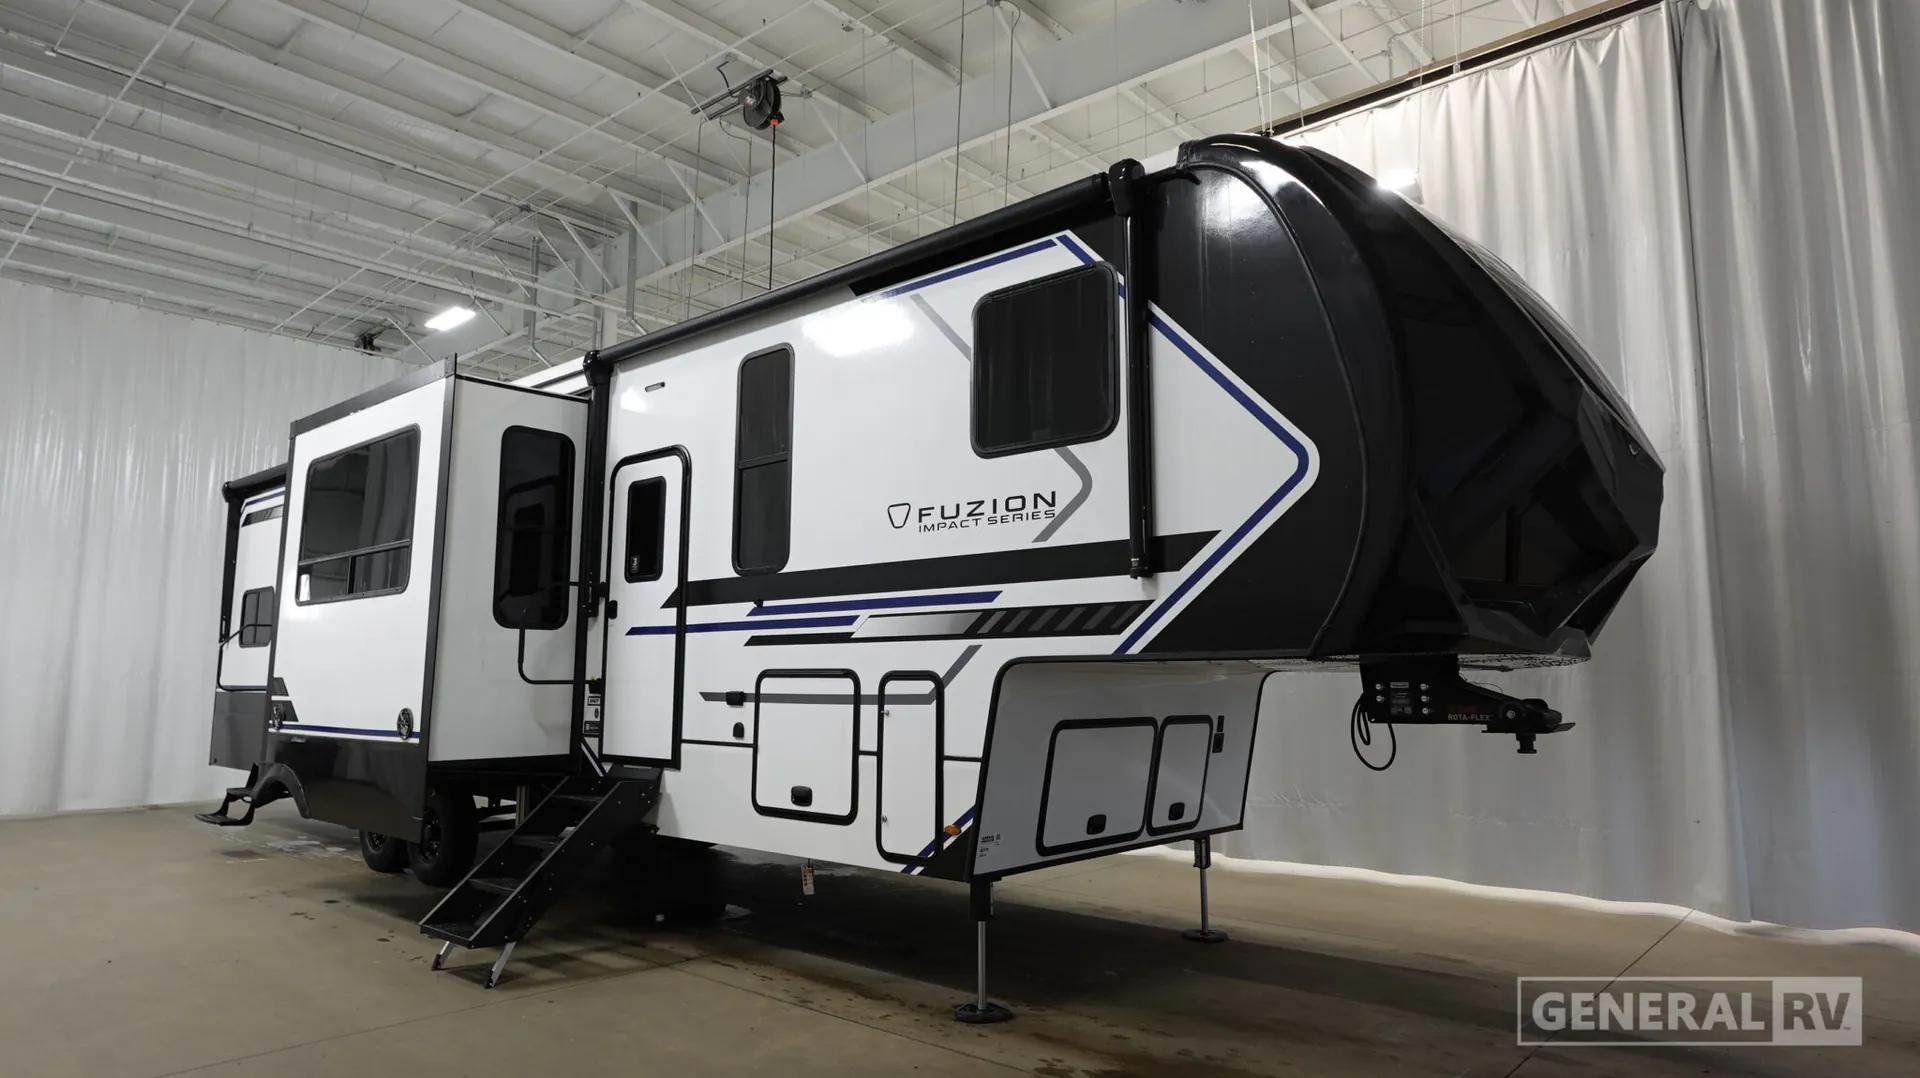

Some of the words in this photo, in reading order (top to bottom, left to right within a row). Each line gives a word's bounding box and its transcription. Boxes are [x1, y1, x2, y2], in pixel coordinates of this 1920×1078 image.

[918, 491, 1056, 523] FUZION
[918, 517, 982, 533] IMPACT
[987, 509, 1056, 525] SERIES
[1447, 713, 1491, 721] ROTA-FLEX
